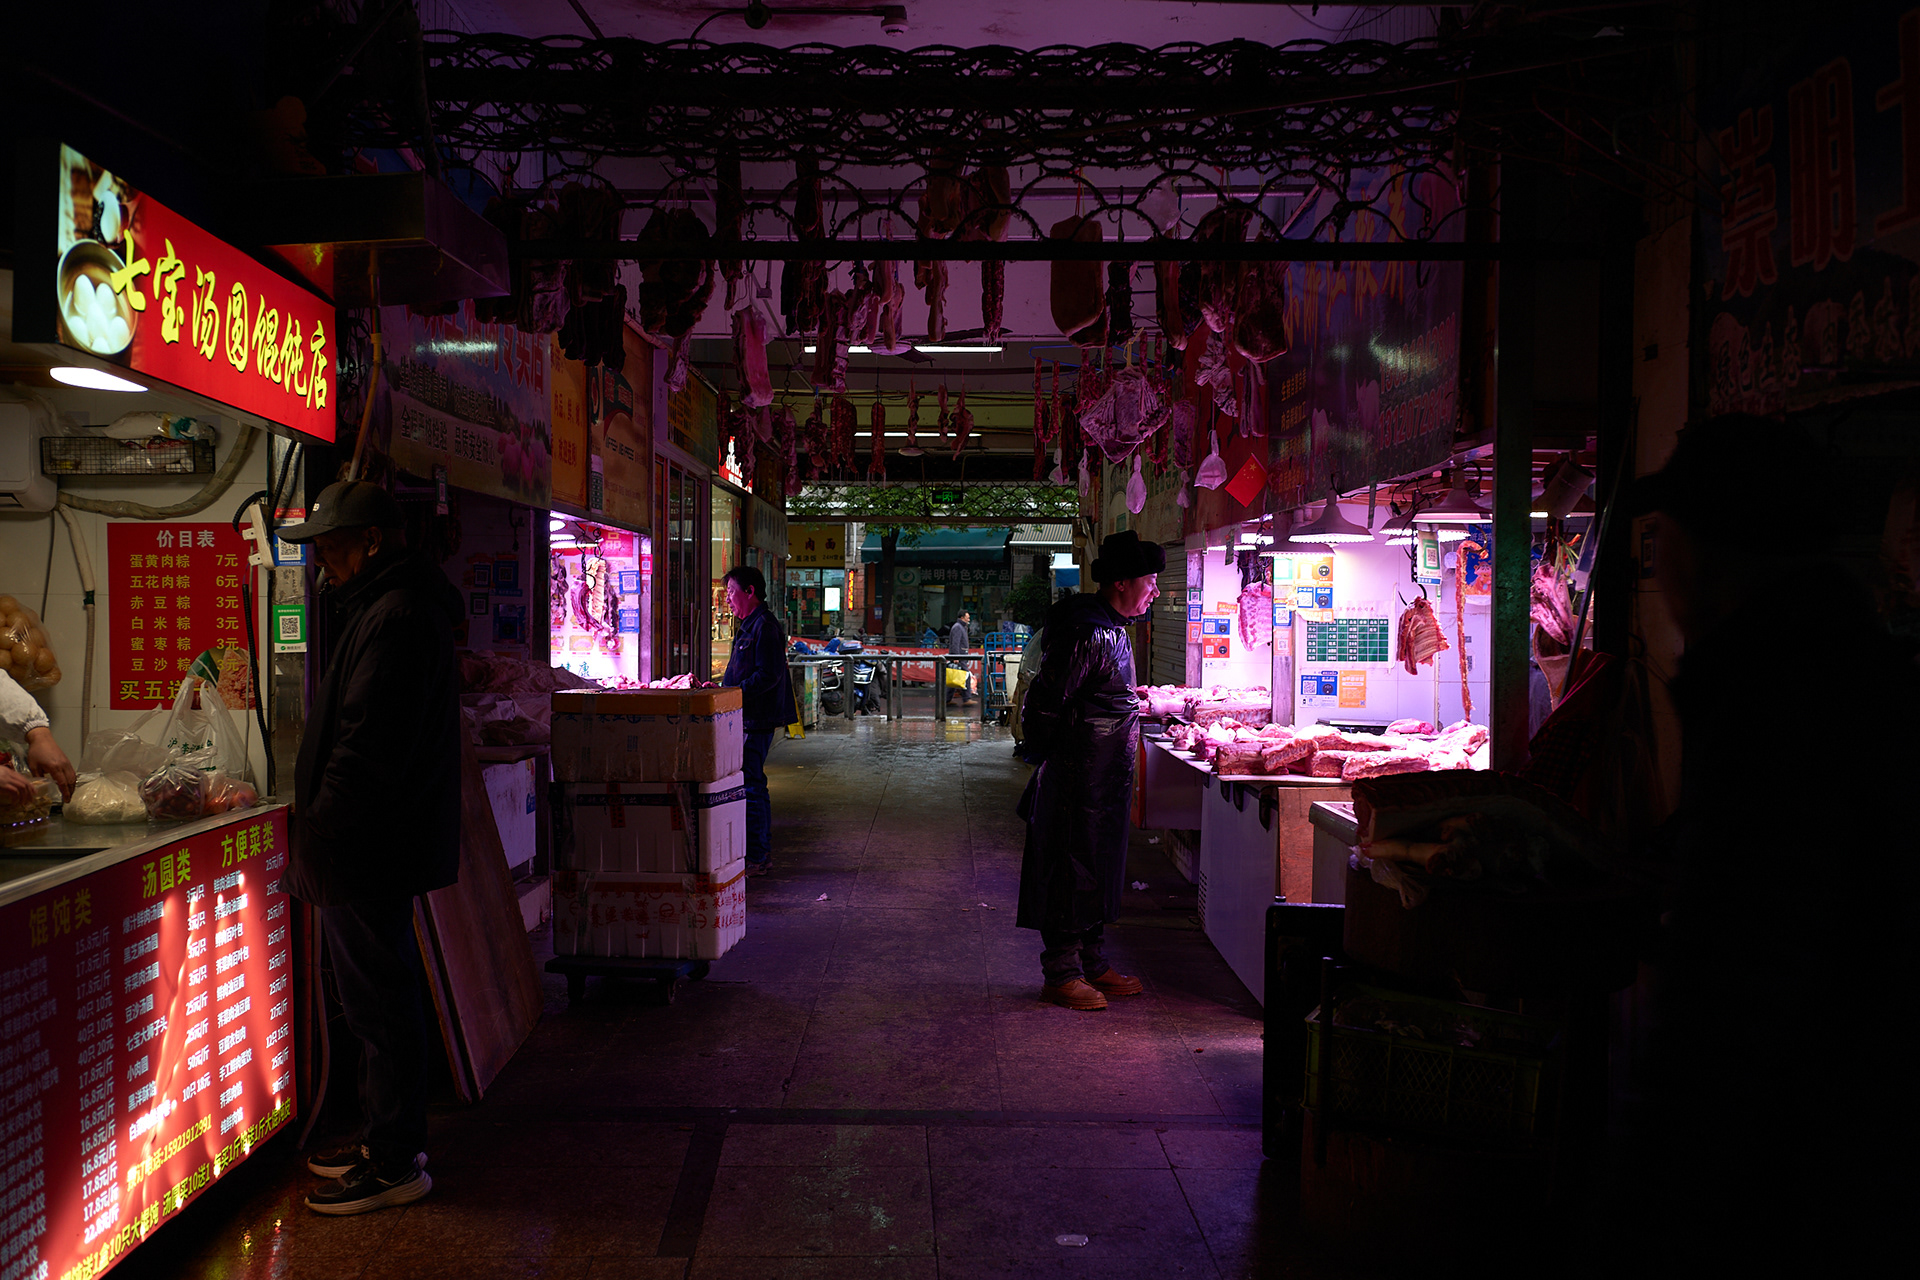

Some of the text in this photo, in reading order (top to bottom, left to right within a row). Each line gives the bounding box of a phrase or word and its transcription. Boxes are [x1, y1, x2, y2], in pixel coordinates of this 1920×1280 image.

[110, 229, 328, 409] 七宝汤圆馄饨店
[156, 530, 215, 548] 价目表
[788, 538, 836, 551] 肉面
[130, 554, 238, 568] 蛋黄肉粽 7元
[920, 568, 1010, 581] 崇明特色农产品
[130, 575, 239, 589] 五花肉粽 6元
[130, 596, 239, 610] 赤豆粽 3元
[131, 616, 239, 630] 白米粽 3元
[131, 637, 239, 651] 蜜枣粽 3元
[131, 658, 240, 672] 豆沙粽 3元
[220, 820, 275, 868] 方便菜类
[142, 847, 192, 899] 汤圆类
[28, 887, 93, 949] 馄饨类
[76, 947, 111, 978] 17.8元/斤
[123, 932, 158, 965] 黑芝麻汤圆
[77, 969, 112, 1001] 17.8元/斤
[125, 993, 154, 1024] 豆沙汤圆
[126, 1015, 168, 1052] 七宝大狮子头
[79, 1055, 114, 1090] 17.8元/斤
[80, 1076, 115, 1112] 16.8元/斤
[80, 1097, 115, 1134] 16.8元/斤
[81, 1119, 116, 1156] 16.8元/斤
[82, 1140, 117, 1178] 16.8元/斤
[82, 1161, 118, 1200] 17.8元/斤
[84, 1182, 119, 1222] 17.8元/斤
